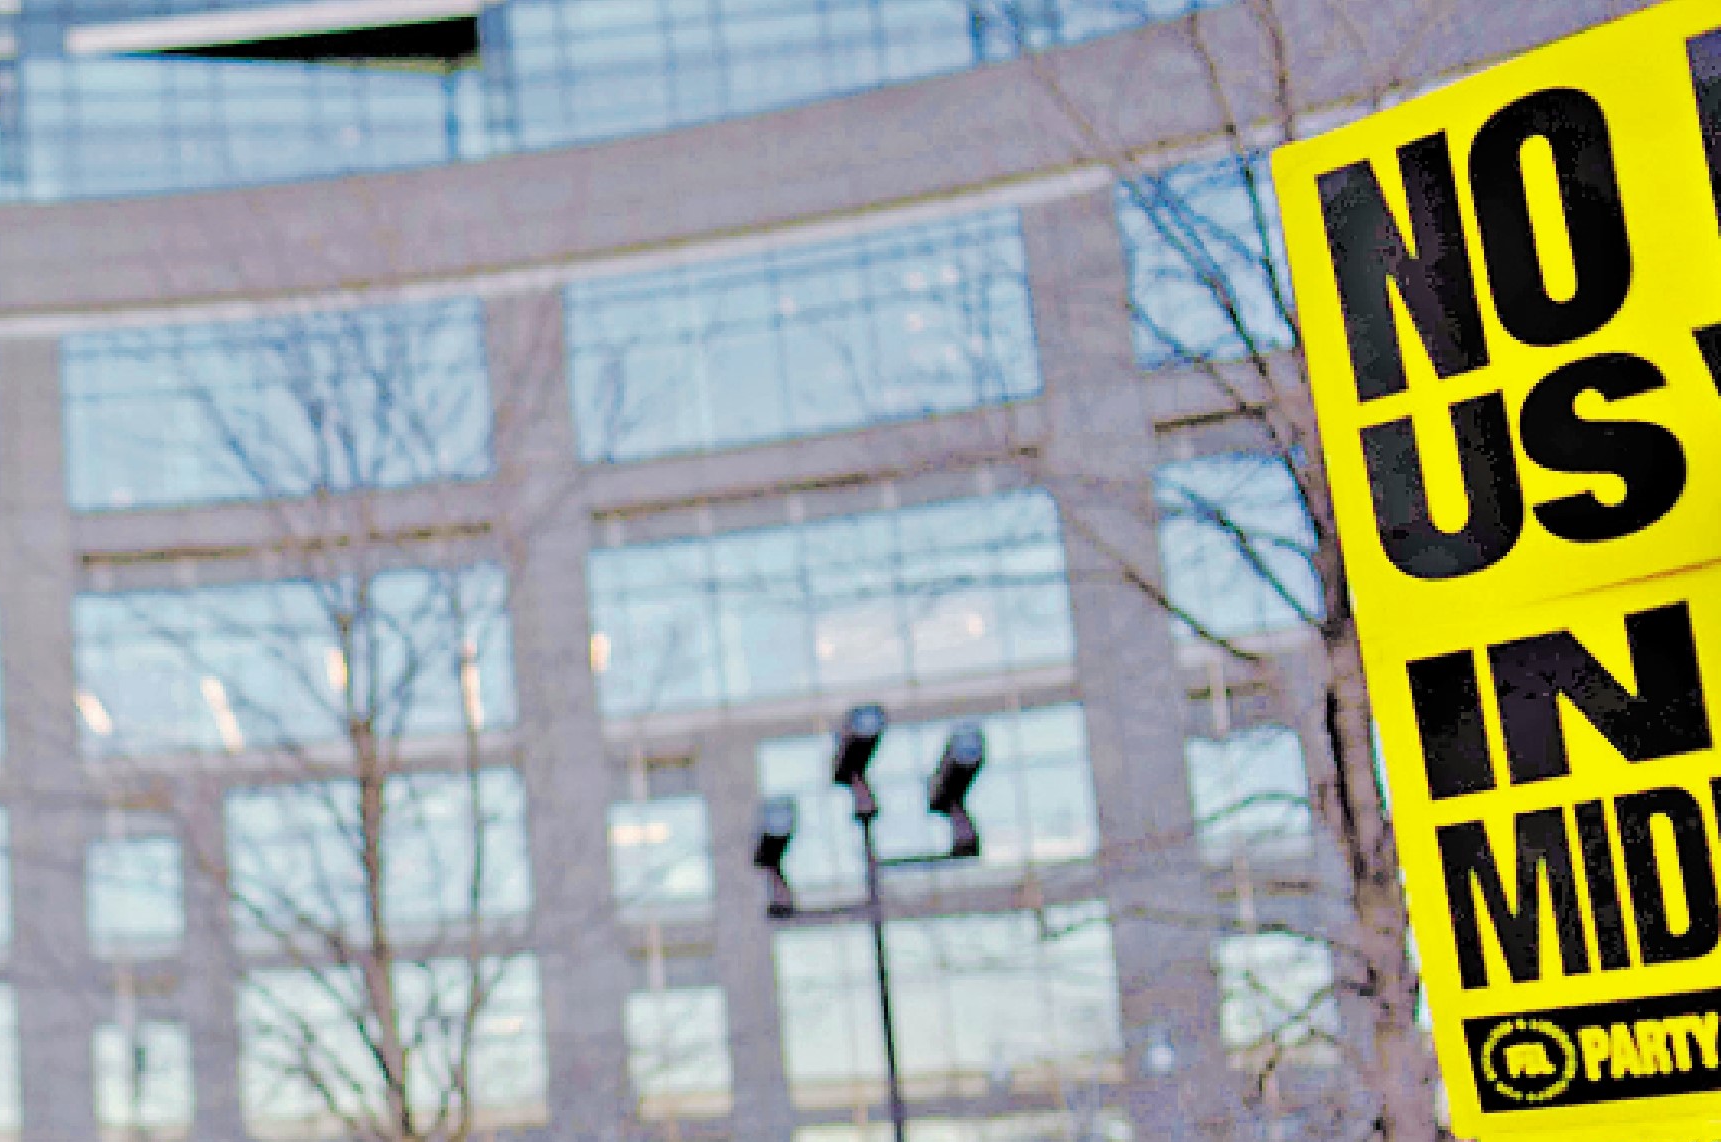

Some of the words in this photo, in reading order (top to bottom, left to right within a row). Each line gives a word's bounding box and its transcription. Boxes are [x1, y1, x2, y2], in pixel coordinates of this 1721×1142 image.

[1314, 86, 1633, 403] NO
[1358, 352, 1688, 581] US
[1406, 600, 1712, 800] IN
[1435, 776, 1721, 990] MID
[1578, 1011, 1719, 1081] PARTY
